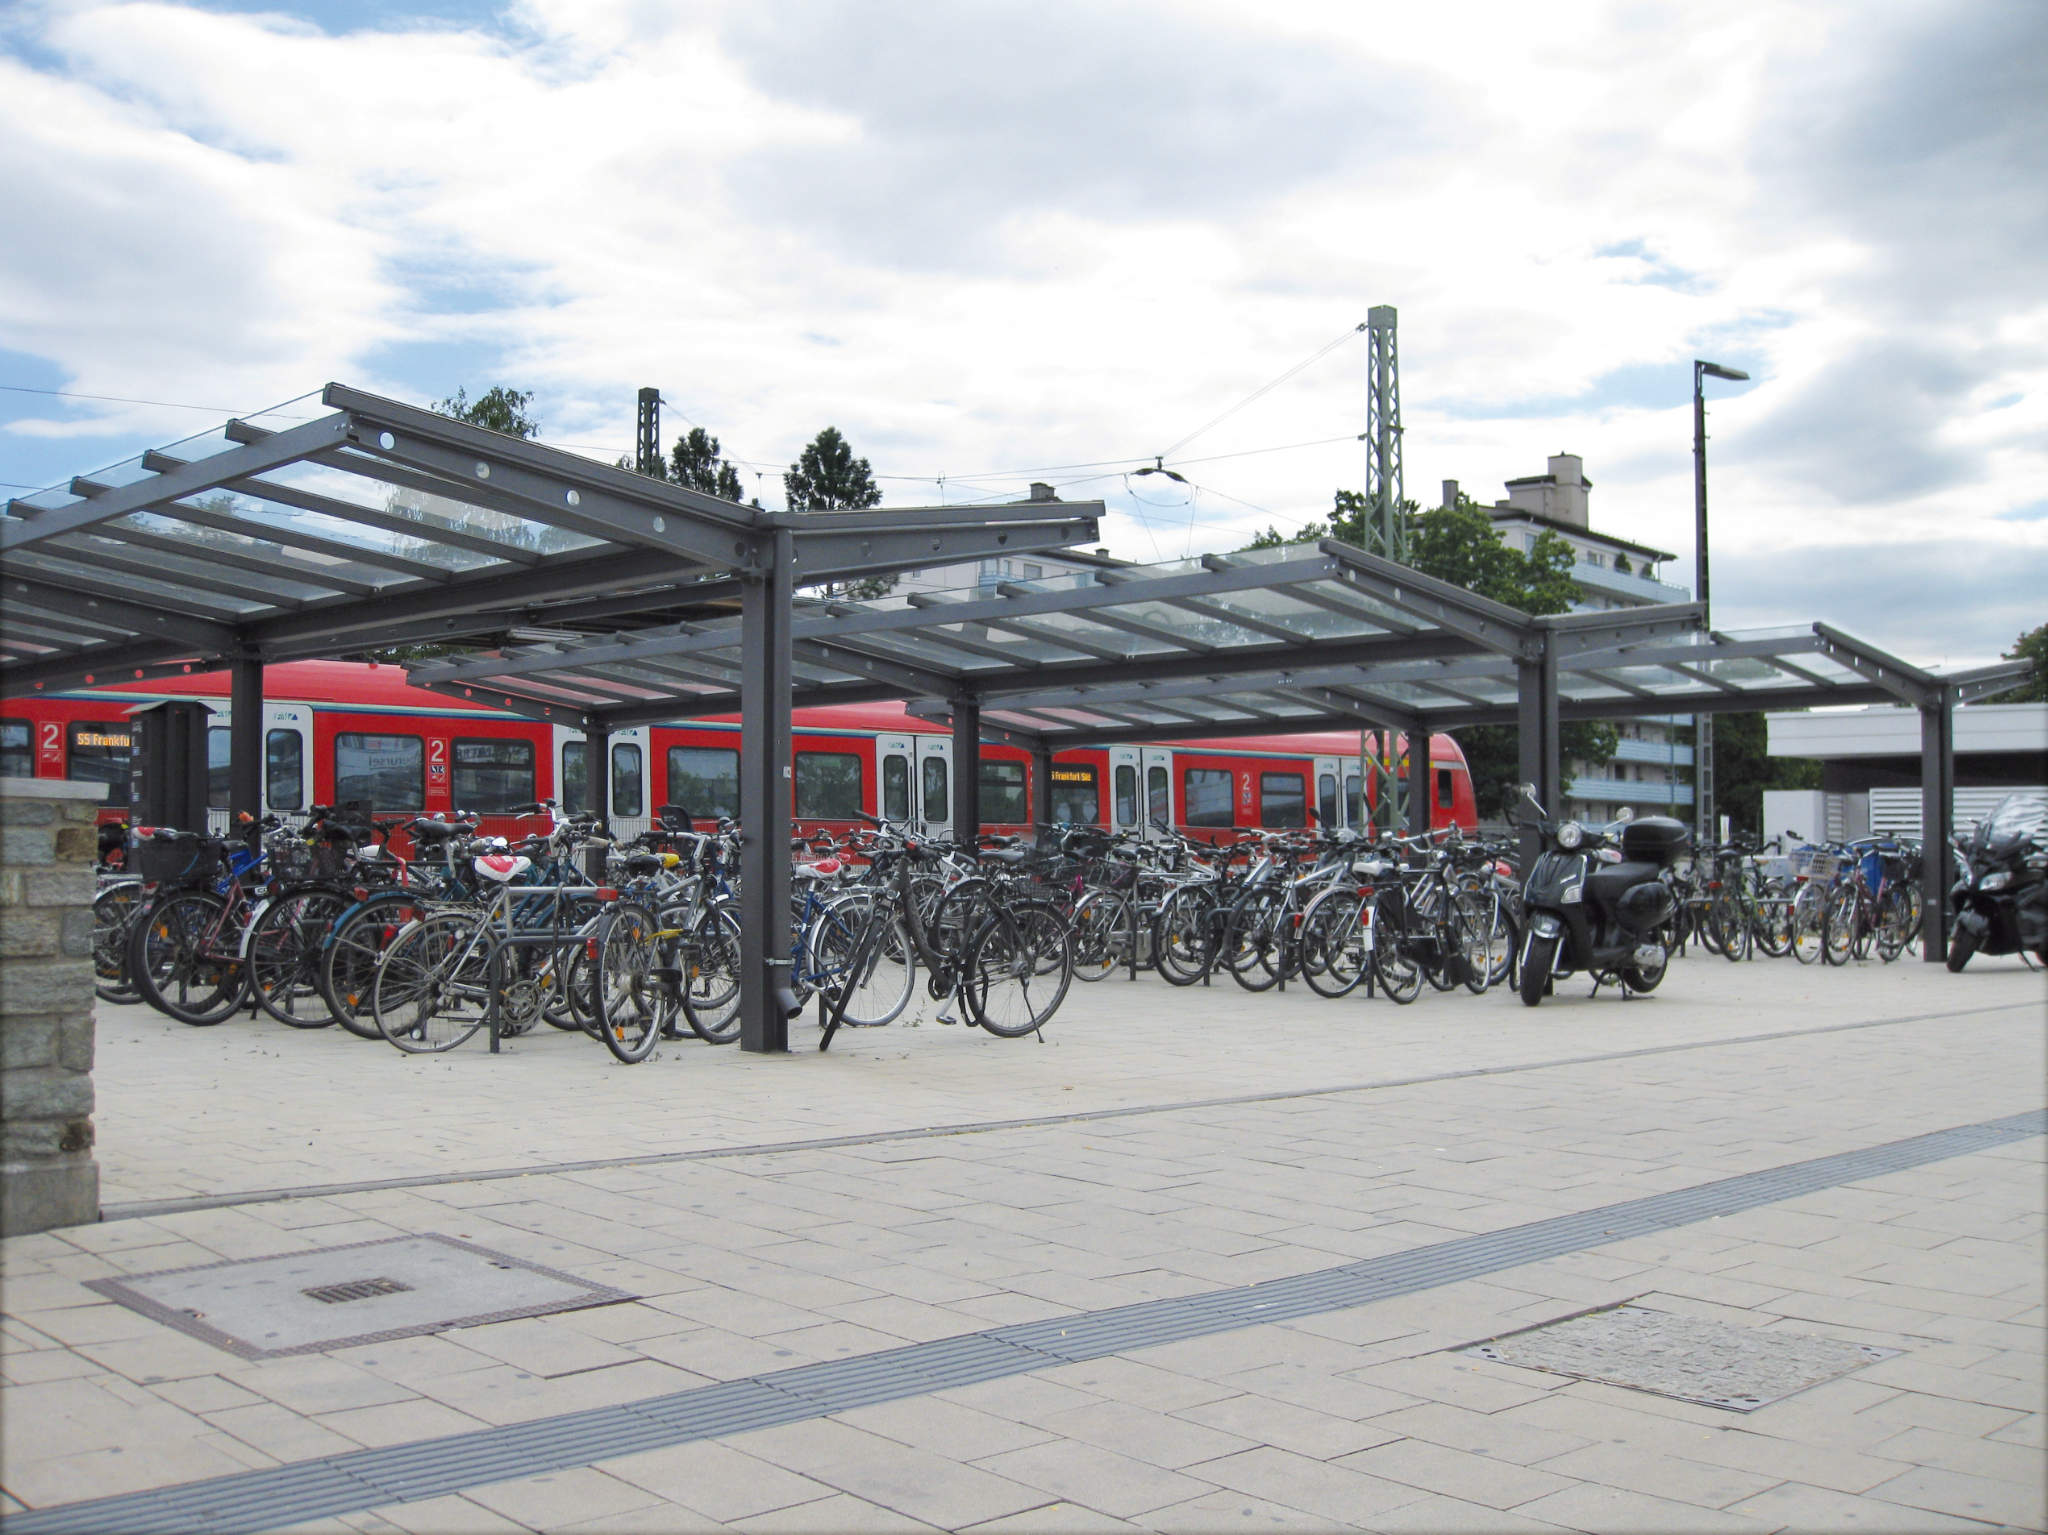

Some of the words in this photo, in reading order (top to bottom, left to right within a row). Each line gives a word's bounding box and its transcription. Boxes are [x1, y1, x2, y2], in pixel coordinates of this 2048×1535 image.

[43, 724, 59, 749] 2
[93, 733, 131, 747] Frankfu
[431, 740, 444, 762] 2
[1242, 773, 1250, 790] 2
